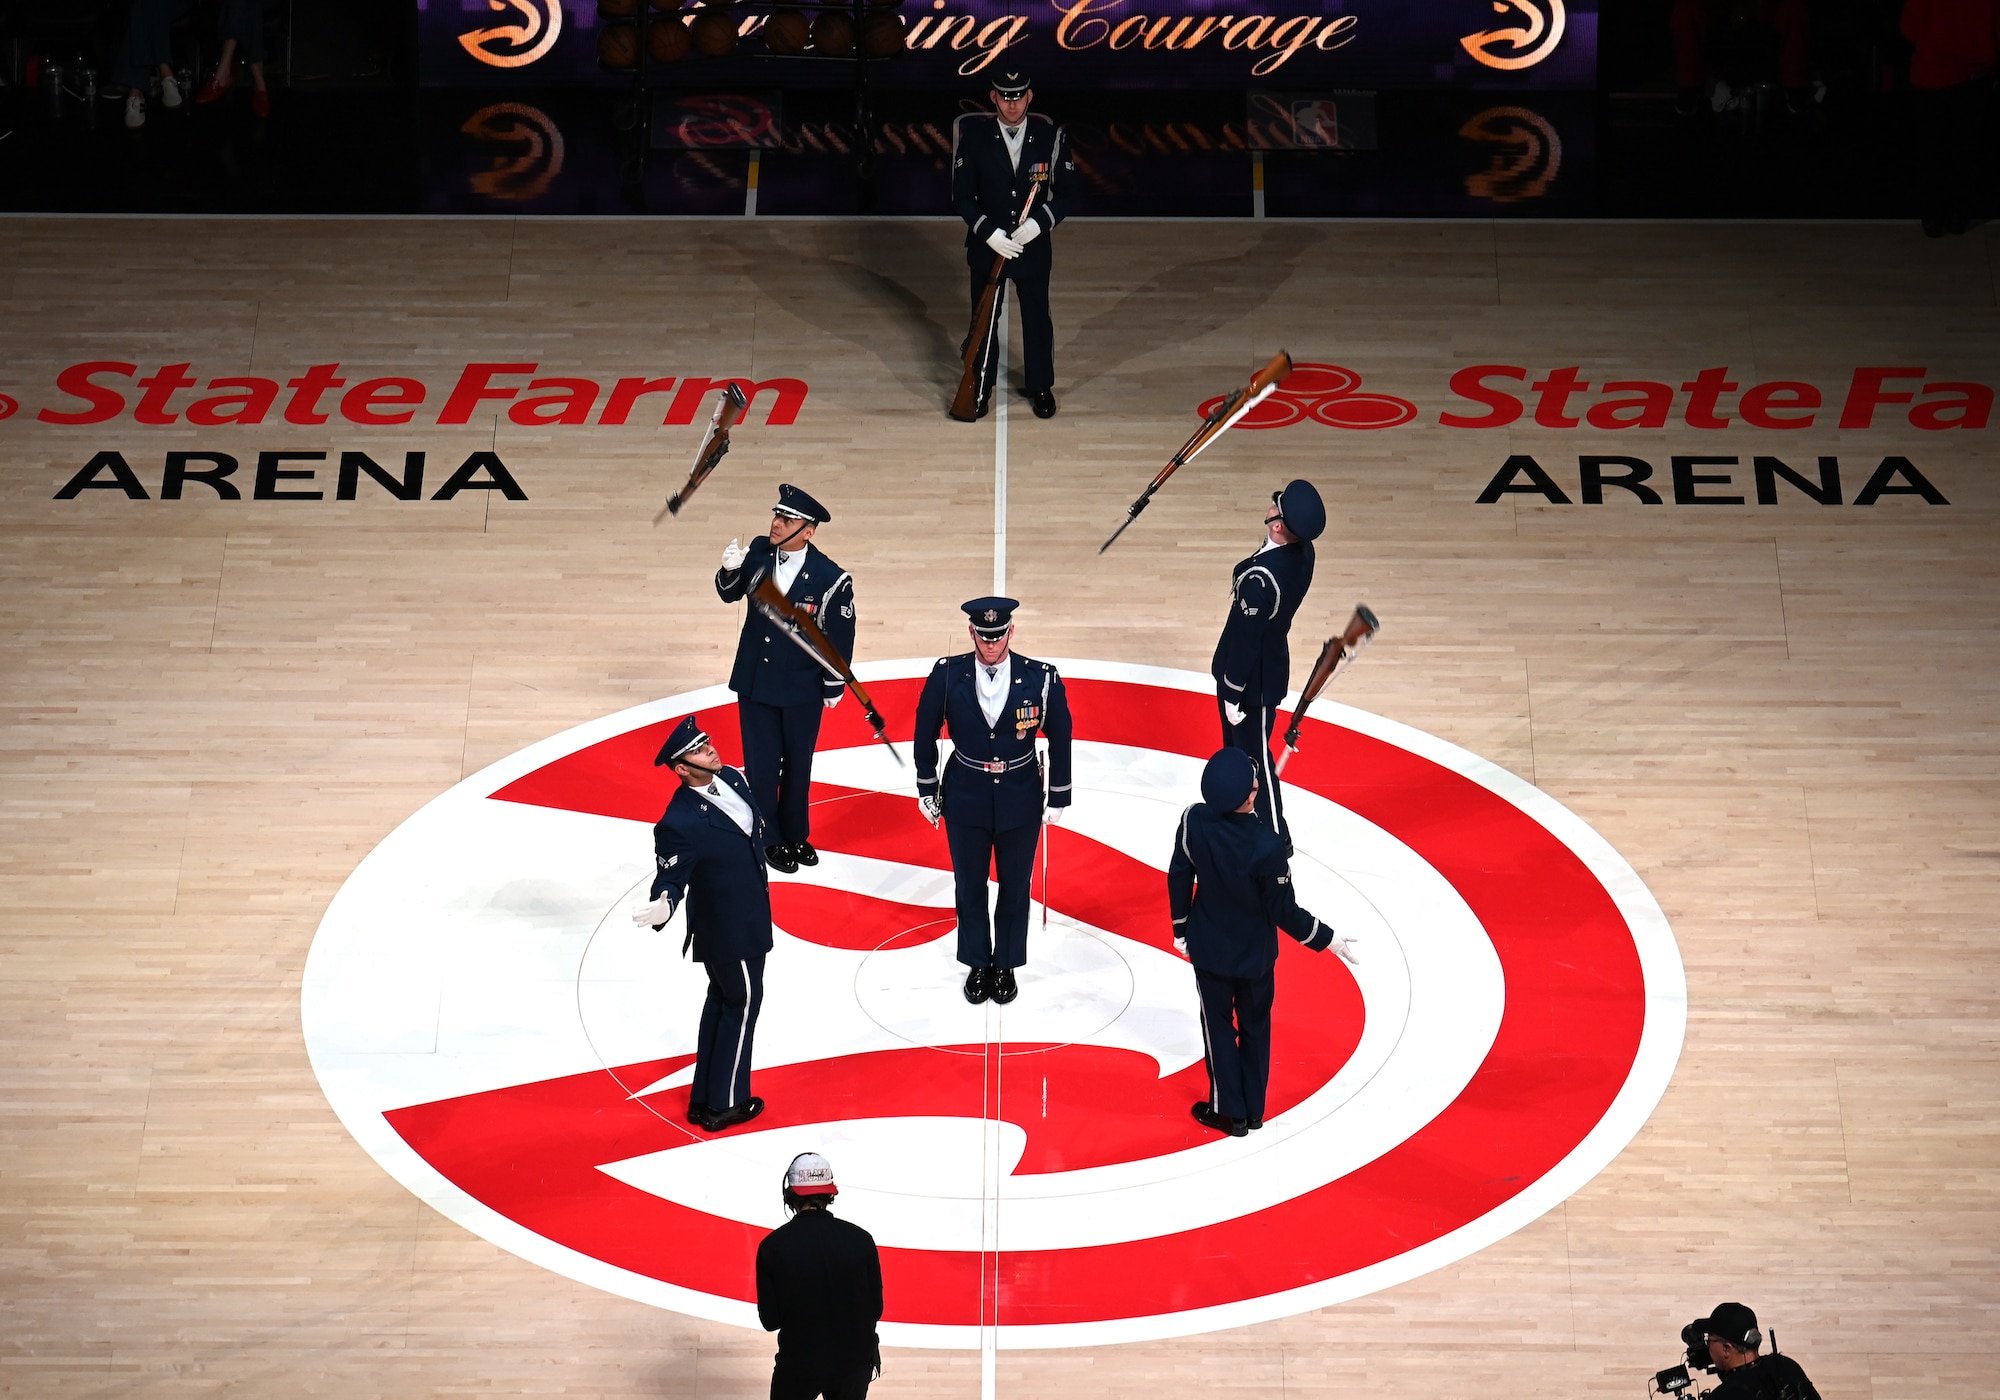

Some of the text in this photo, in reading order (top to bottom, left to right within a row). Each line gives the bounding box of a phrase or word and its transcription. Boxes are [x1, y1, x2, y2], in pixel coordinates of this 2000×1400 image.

[1052, 0, 1358, 76] Courage
[52, 451, 530, 501] ARENA
[1474, 454, 1952, 506] ARENA
